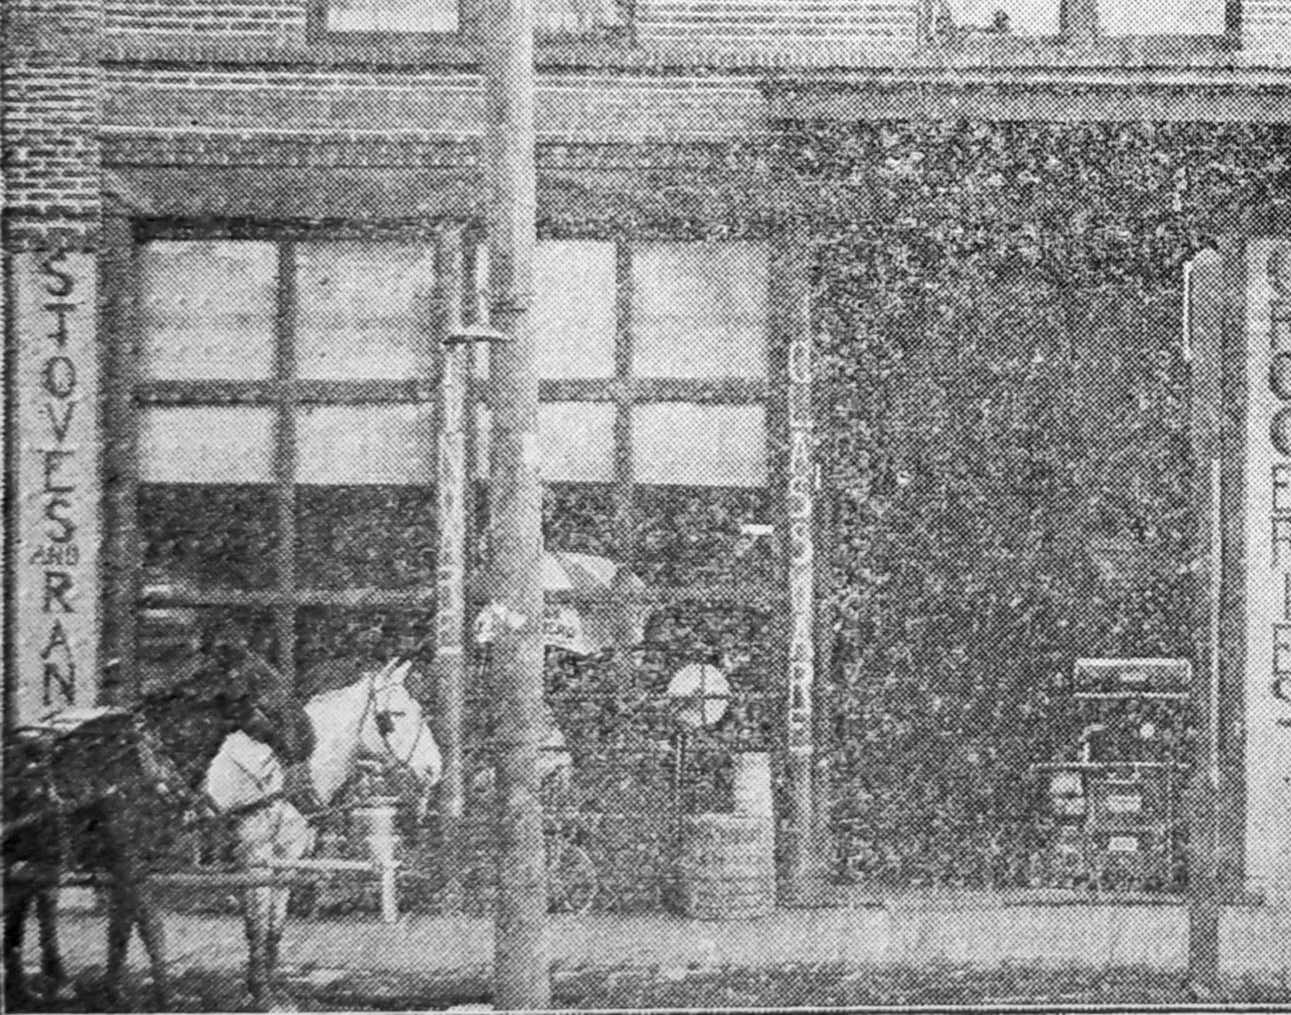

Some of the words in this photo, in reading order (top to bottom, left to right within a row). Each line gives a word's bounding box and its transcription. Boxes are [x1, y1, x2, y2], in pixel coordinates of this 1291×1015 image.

[44, 247, 78, 543] STOVES
[31, 544, 79, 565] AND
[788, 340, 814, 754] GLASSWARE
